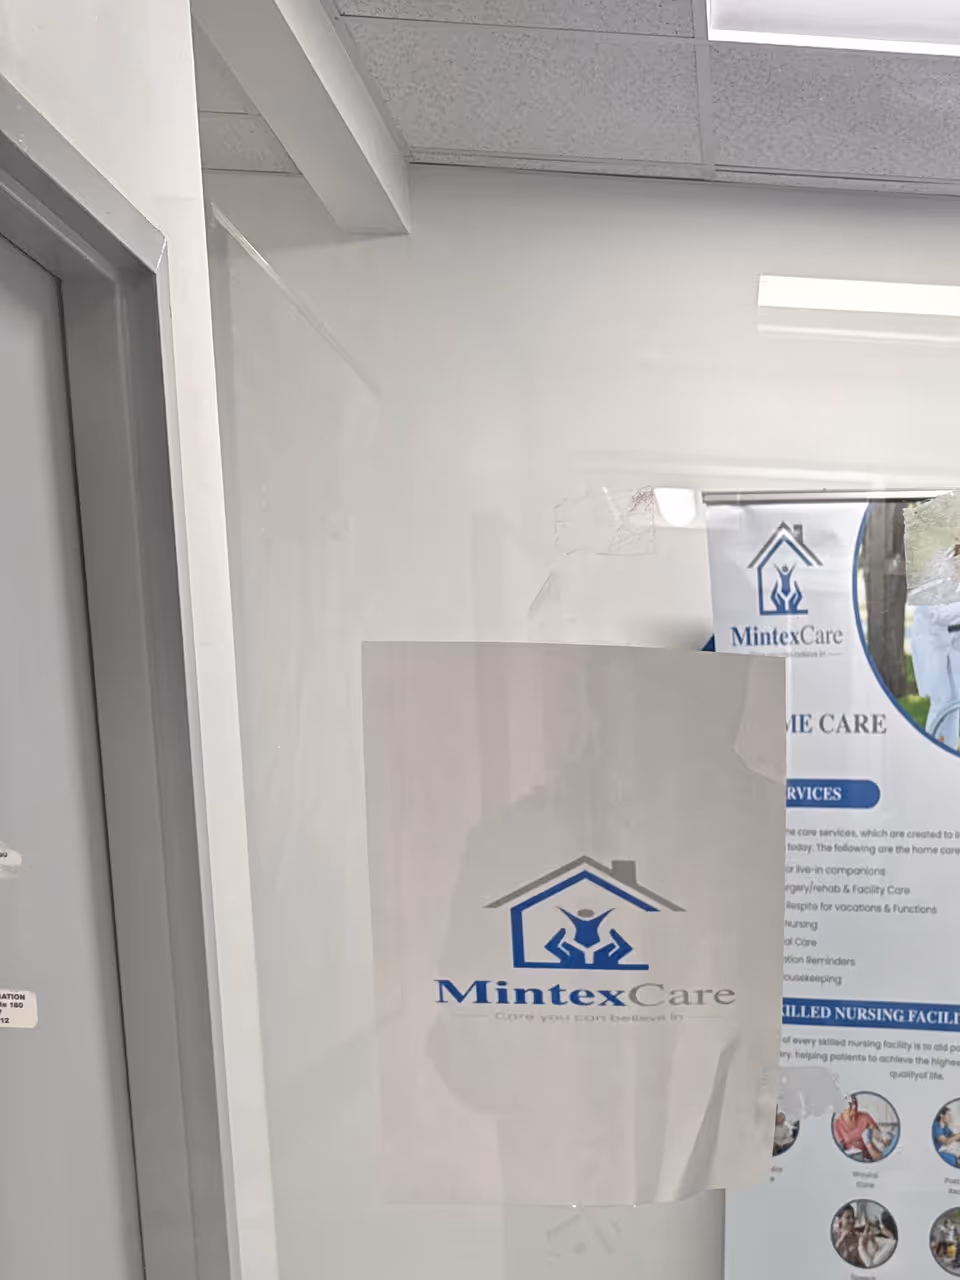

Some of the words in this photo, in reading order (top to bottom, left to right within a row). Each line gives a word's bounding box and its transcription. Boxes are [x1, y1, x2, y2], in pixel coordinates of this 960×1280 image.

[732, 624, 843, 646] MintexCare
[819, 714, 887, 734] CARE
[786, 786, 842, 801] RVICES
[820, 829, 858, 838] services,
[860, 830, 887, 838] which
[907, 830, 941, 839] created
[944, 831, 953, 839] to
[817, 843, 832, 852] The
[834, 844, 876, 855] following
[896, 845, 910, 854] the
[912, 846, 937, 854] home
[796, 864, 823, 874] live-in
[825, 866, 885, 876] companions
[843, 885, 850, 893] &
[852, 885, 885, 896] Facility
[887, 885, 910, 895] Care
[786, 901, 818, 912] Respite
[820, 902, 832, 911] for
[835, 903, 882, 912] vacations
[884, 904, 891, 913] &
[893, 904, 937, 914] Functions
[794, 938, 817, 947] Care
[806, 956, 855, 966] Reminders
[434, 980, 736, 1008] MintexCare
[835, 1007, 904, 1022] NURSING
[793, 1037, 816, 1047] every
[818, 1038, 846, 1047] skilled
[848, 1040, 881, 1050] nursing
[883, 1040, 912, 1051] facility
[914, 1042, 921, 1050] is
[923, 1043, 932, 1051] to
[795, 1051, 827, 1061] helping
[830, 1052, 866, 1062] patients
[868, 1054, 877, 1062] to
[879, 1055, 913, 1063] achieve
[915, 1056, 929, 1065] the
